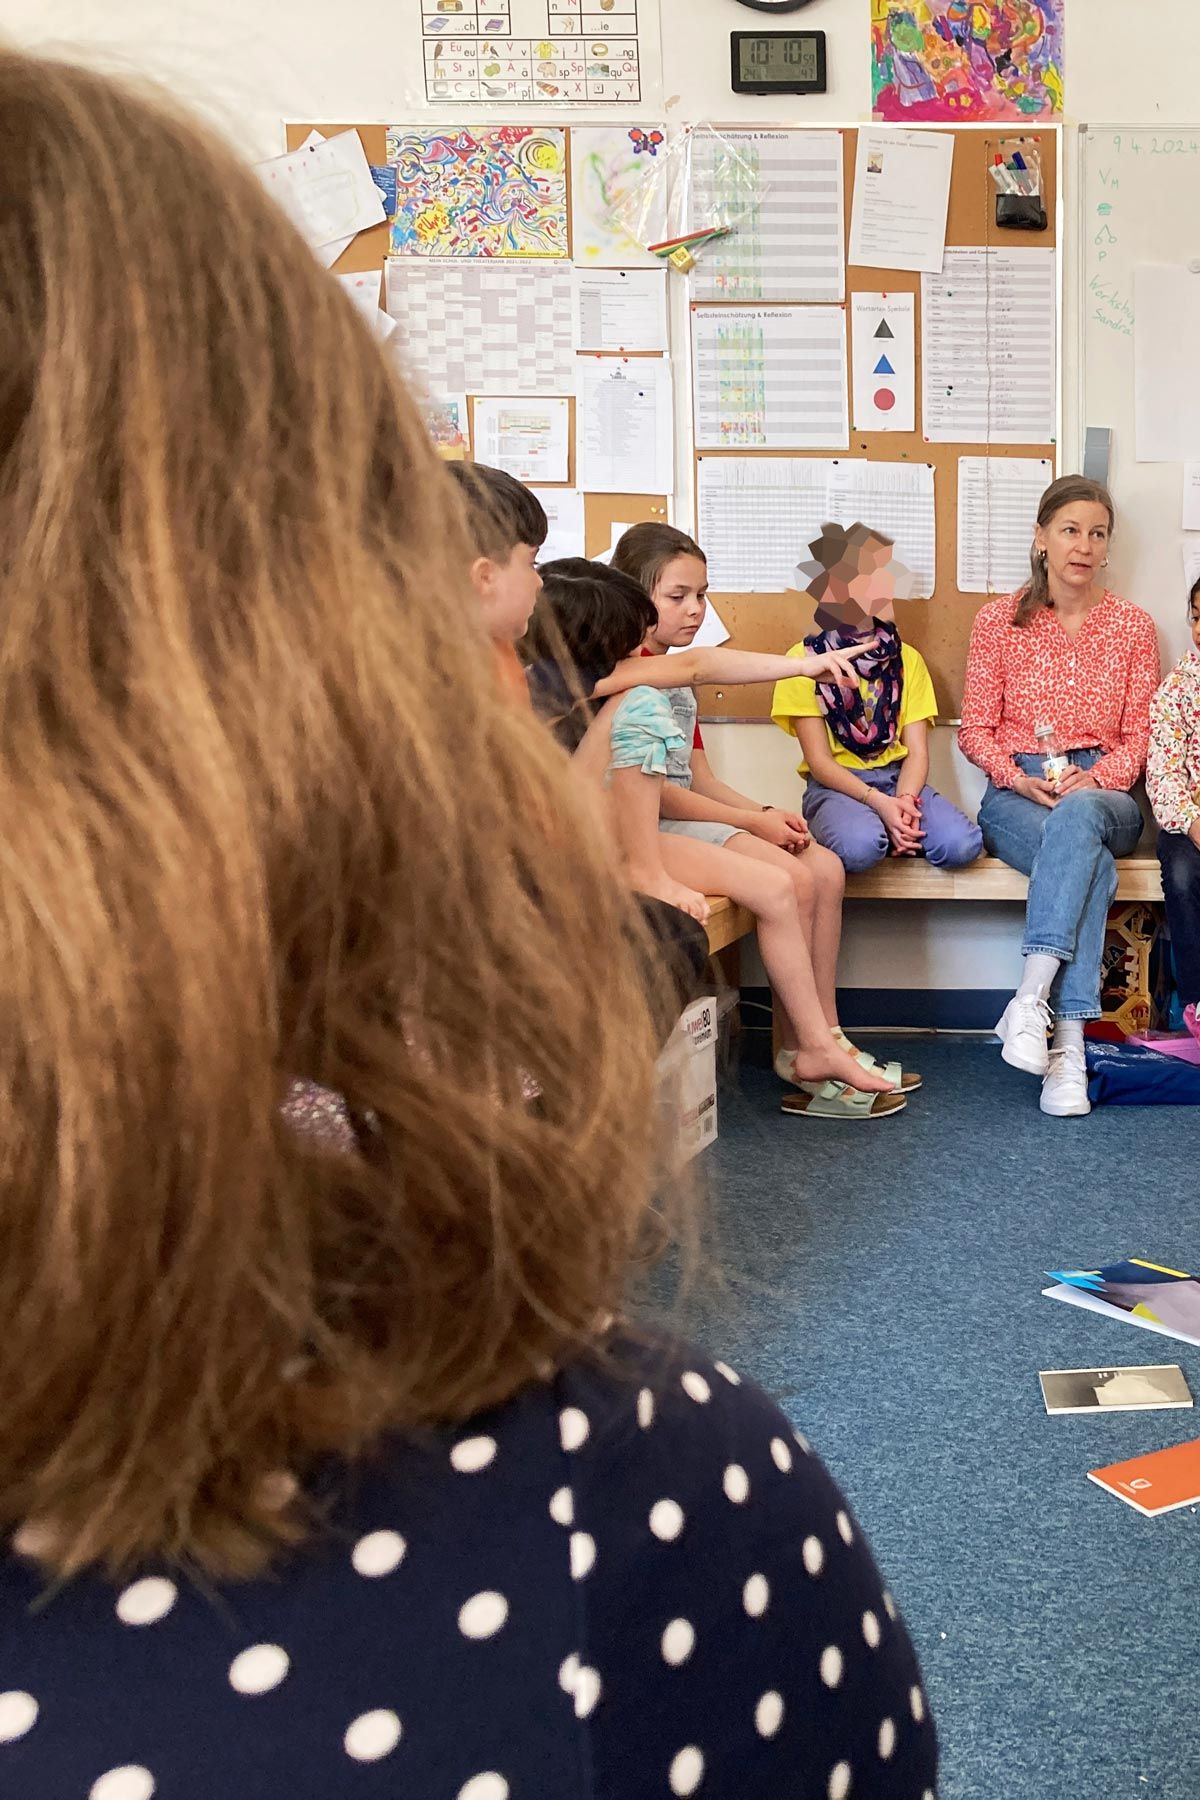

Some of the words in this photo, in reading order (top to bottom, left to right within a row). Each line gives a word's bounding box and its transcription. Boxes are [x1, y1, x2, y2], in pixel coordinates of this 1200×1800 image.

[450, 42, 462, 52] Eu
[464, 49, 476, 57] eu
[751, 40, 802, 65] 10:10
[453, 62, 462, 72] St
[468, 69, 475, 77] st
[559, 69, 570, 80] sp
[571, 62, 584, 75] Sp
[610, 69, 622, 80] qu
[622, 62, 638, 73] Qu
[760, 132, 789, 140] Reflexion
[696, 312, 756, 320] Selbsteinschätzung
